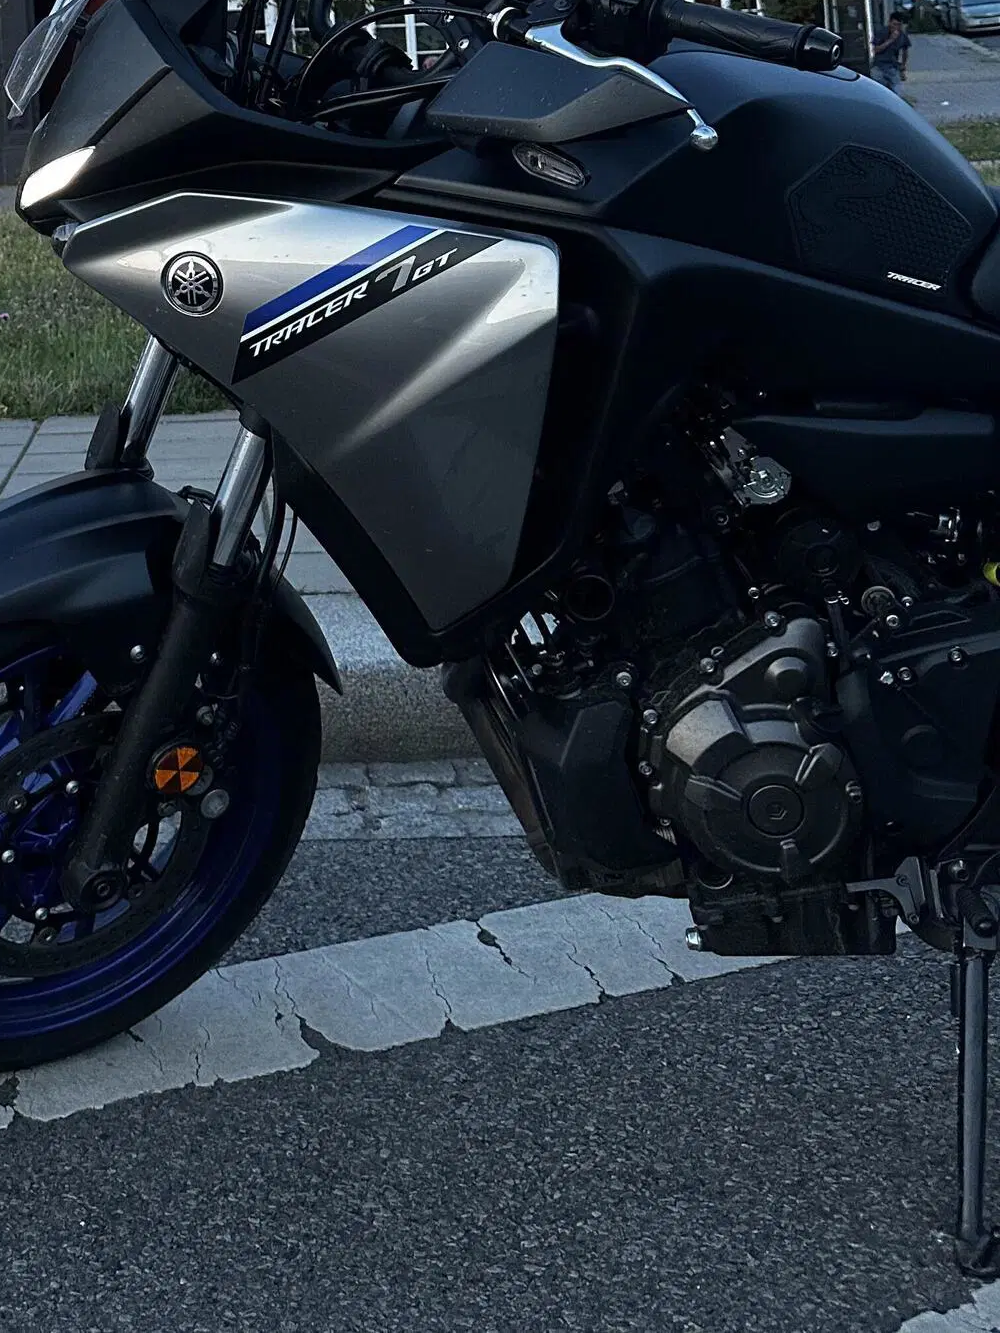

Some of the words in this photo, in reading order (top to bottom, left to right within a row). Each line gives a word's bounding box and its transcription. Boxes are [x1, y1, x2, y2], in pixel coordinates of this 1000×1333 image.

[249, 280, 370, 358] TRACER
[374, 255, 416, 293] 7
[411, 247, 458, 282] GT
[887, 271, 942, 291] TRACER
